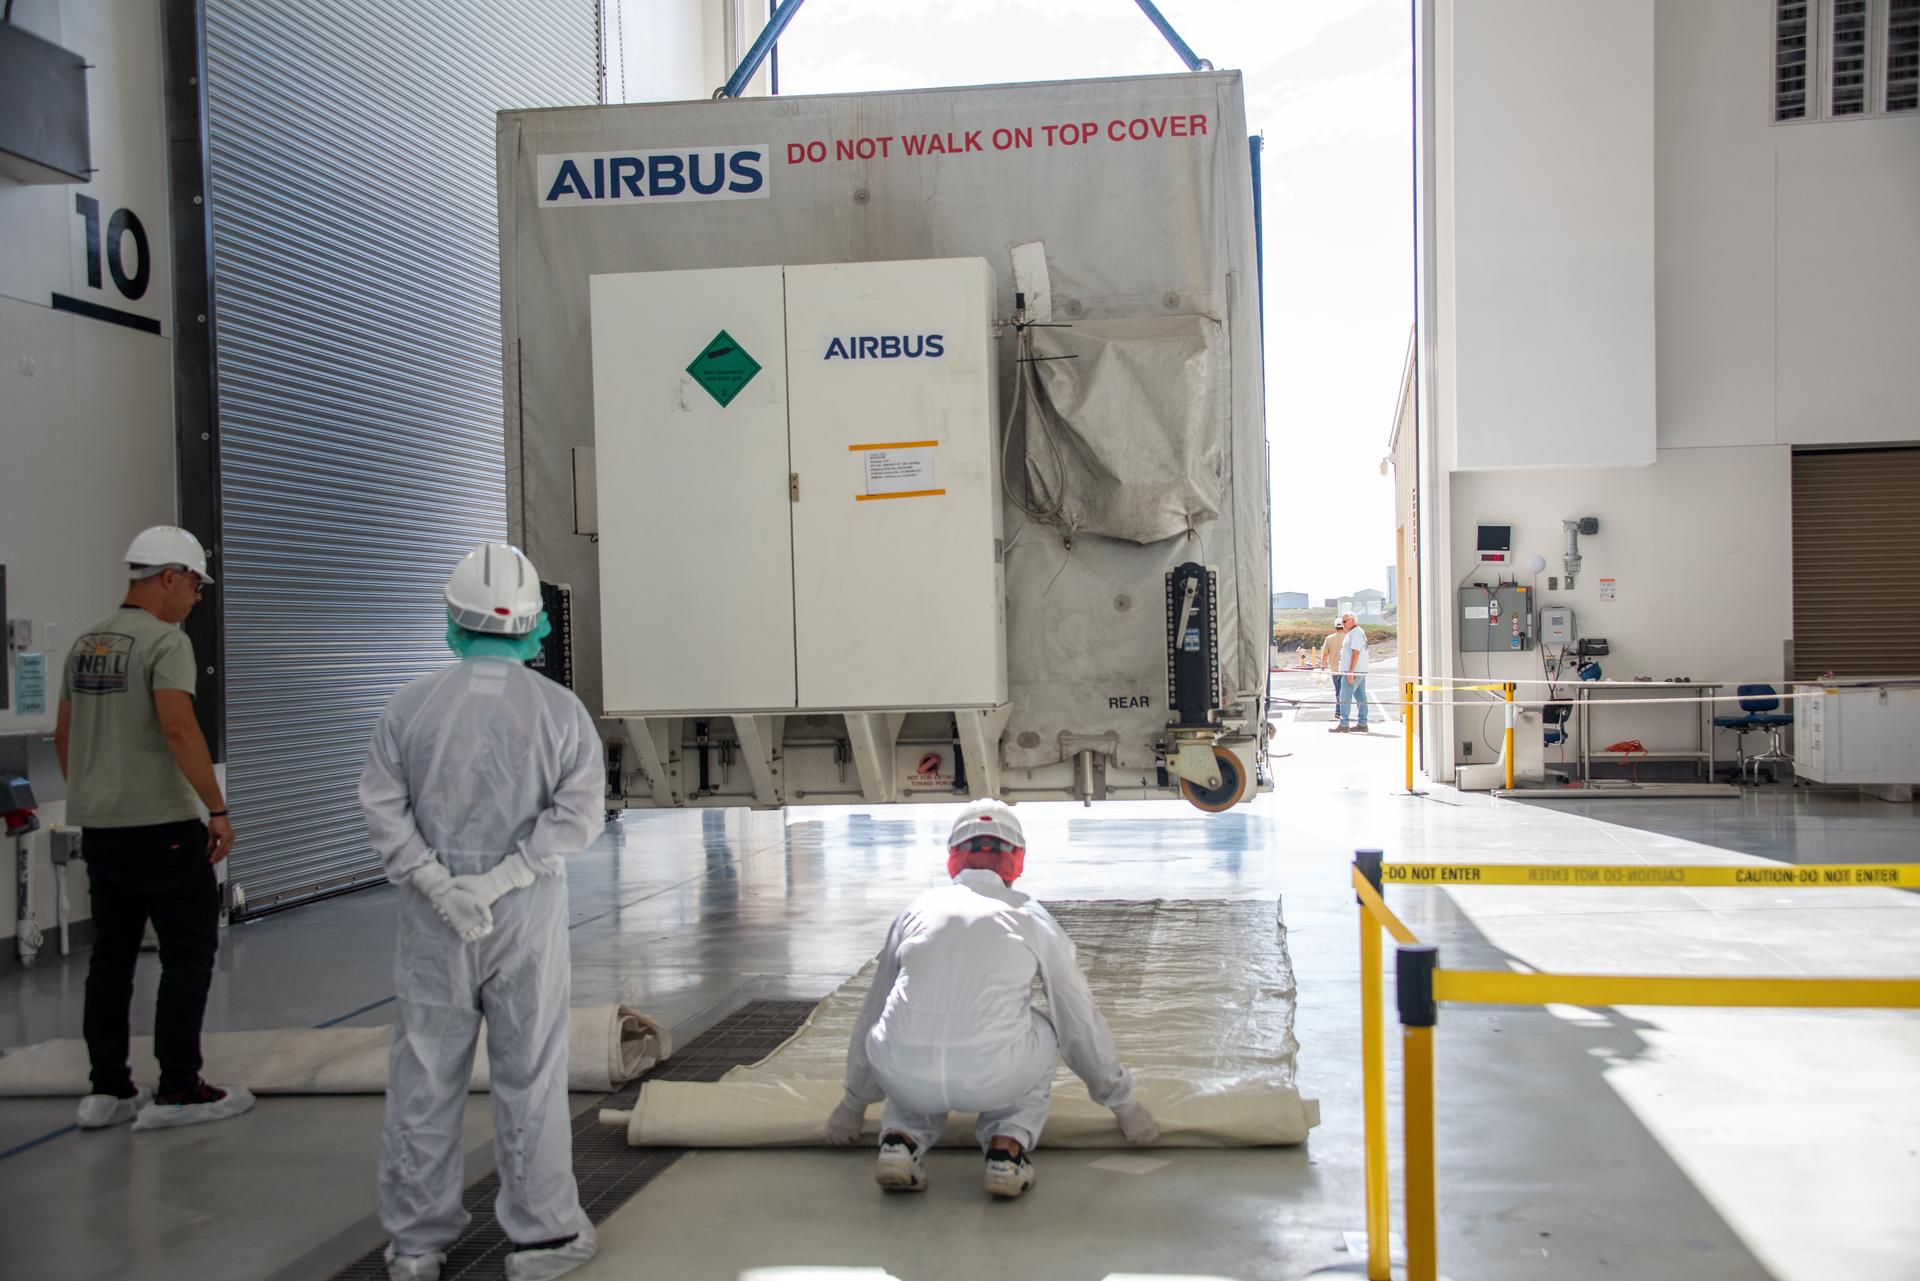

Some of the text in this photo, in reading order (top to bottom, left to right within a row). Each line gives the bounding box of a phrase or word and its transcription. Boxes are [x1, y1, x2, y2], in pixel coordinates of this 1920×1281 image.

[786, 114, 1208, 165] DO NOT WALK ON TOP COVER
[545, 151, 763, 201] AIRBUS
[75, 192, 151, 301] 10
[824, 334, 944, 360] AIRBUS
[1109, 696, 1150, 709] REAR
[1411, 867, 1437, 880] NOT
[1441, 867, 1481, 880] ENTER
[1824, 869, 1851, 882] NOT
[1855, 869, 1898, 882] ENTER
